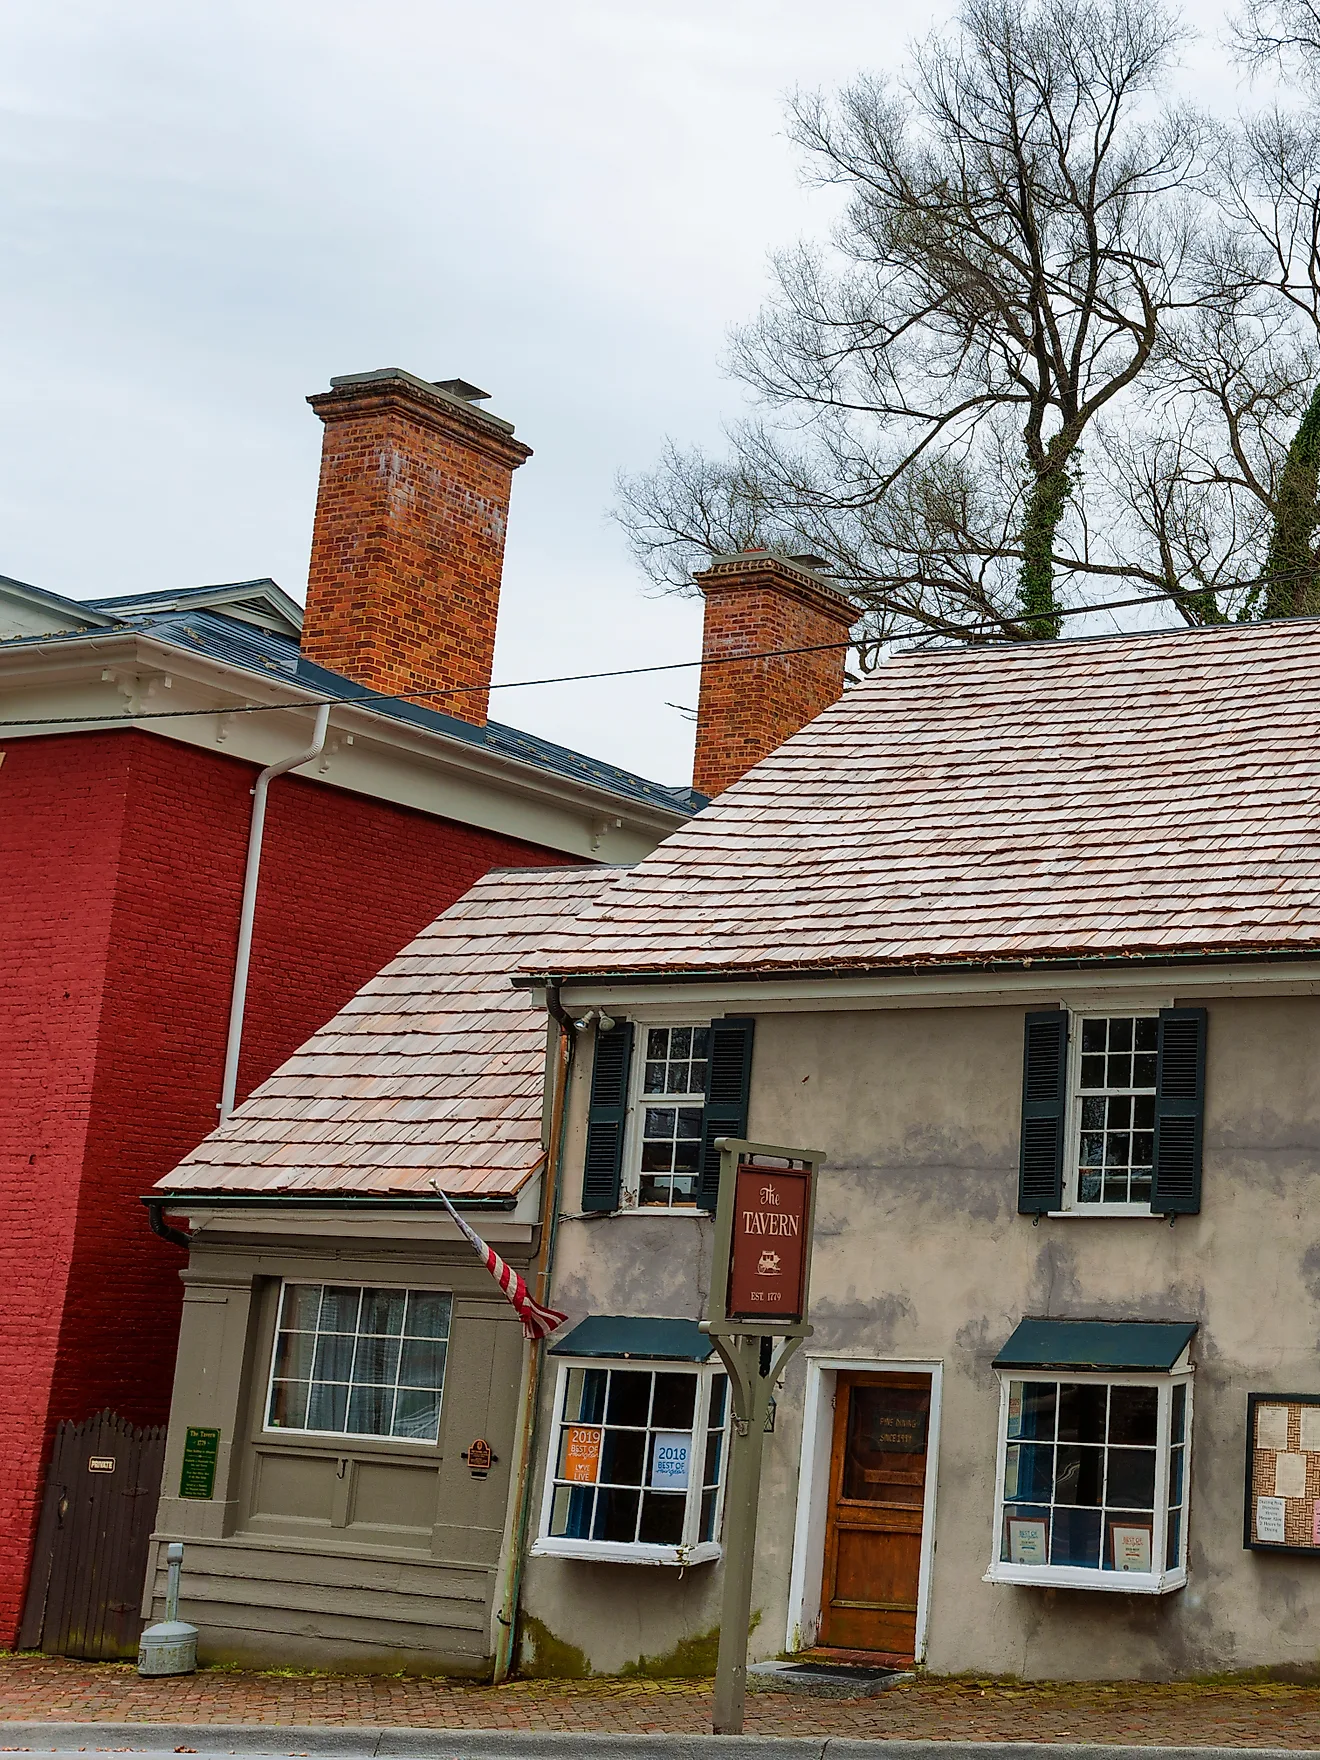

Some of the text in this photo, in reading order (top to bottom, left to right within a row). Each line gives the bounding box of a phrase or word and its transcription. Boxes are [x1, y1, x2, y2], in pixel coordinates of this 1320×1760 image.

[760, 1183, 780, 1206] The
[743, 1211, 799, 1236] TAVERN
[767, 1292, 782, 1301] 1779
[572, 1430, 600, 1444] 2019
[571, 1444, 598, 1454] BEST OF
[659, 1447, 686, 1461] 2018
[91, 1460, 113, 1469] PRIVATE
[658, 1461, 685, 1470] BEST OF
[574, 1472, 590, 1481] LIVE
